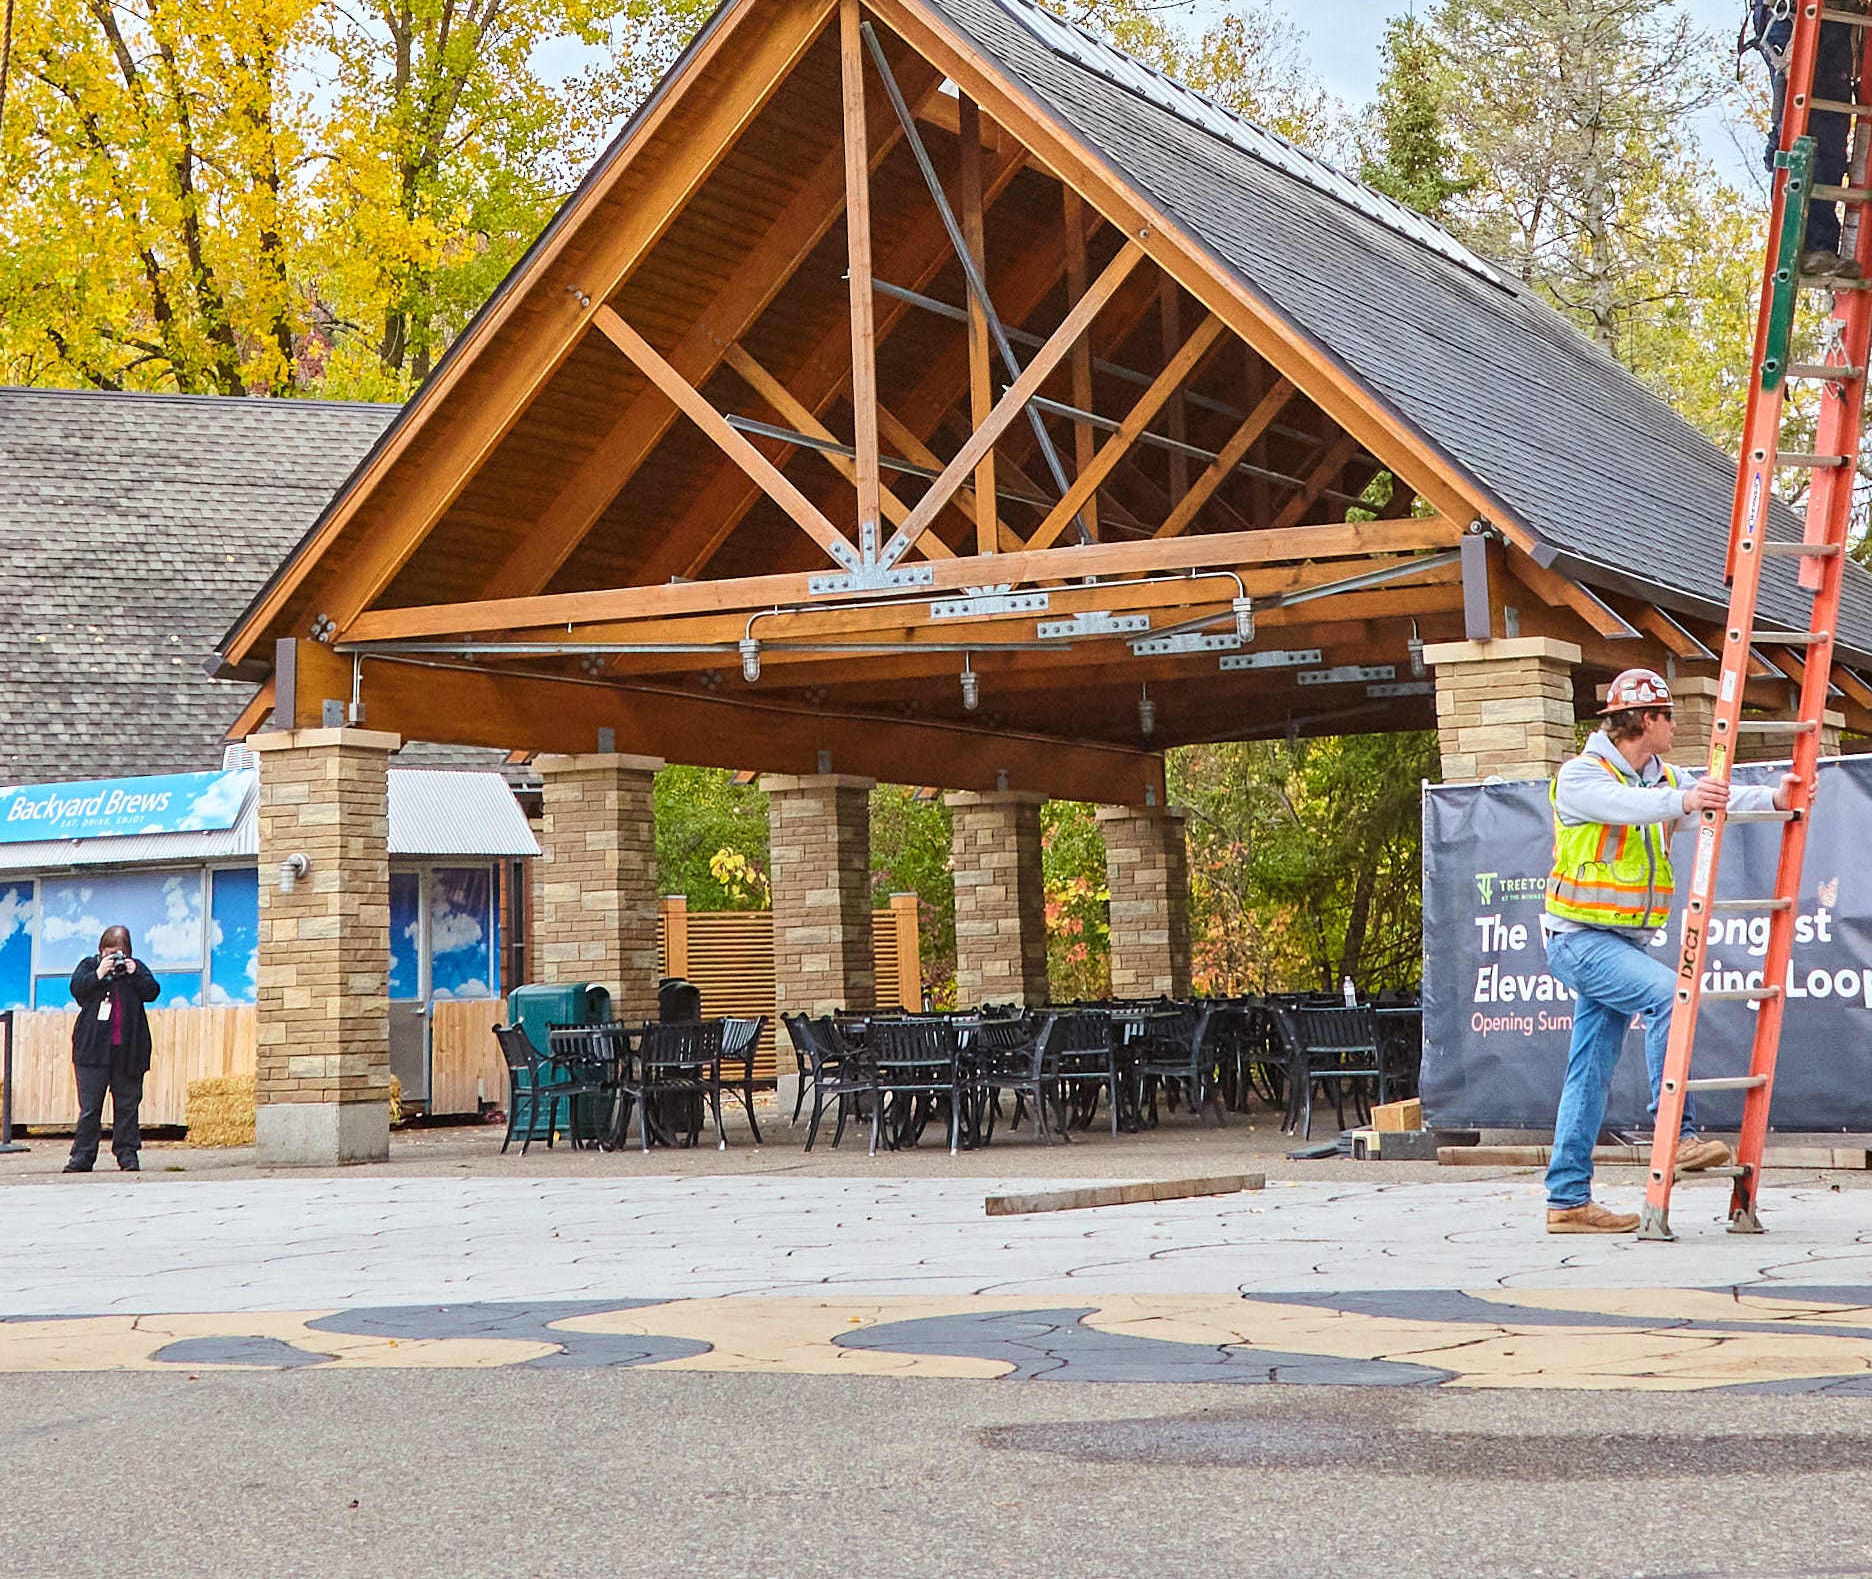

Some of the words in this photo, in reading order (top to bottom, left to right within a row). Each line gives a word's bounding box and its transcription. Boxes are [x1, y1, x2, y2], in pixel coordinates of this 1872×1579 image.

[6, 790, 107, 825] Backyard
[104, 789, 172, 815] Brews
[1499, 878, 1550, 892] TREETO
[1475, 913, 1528, 953] The
[1471, 1012, 1534, 1037] Opening
[1538, 1011, 1572, 1031] Sum
